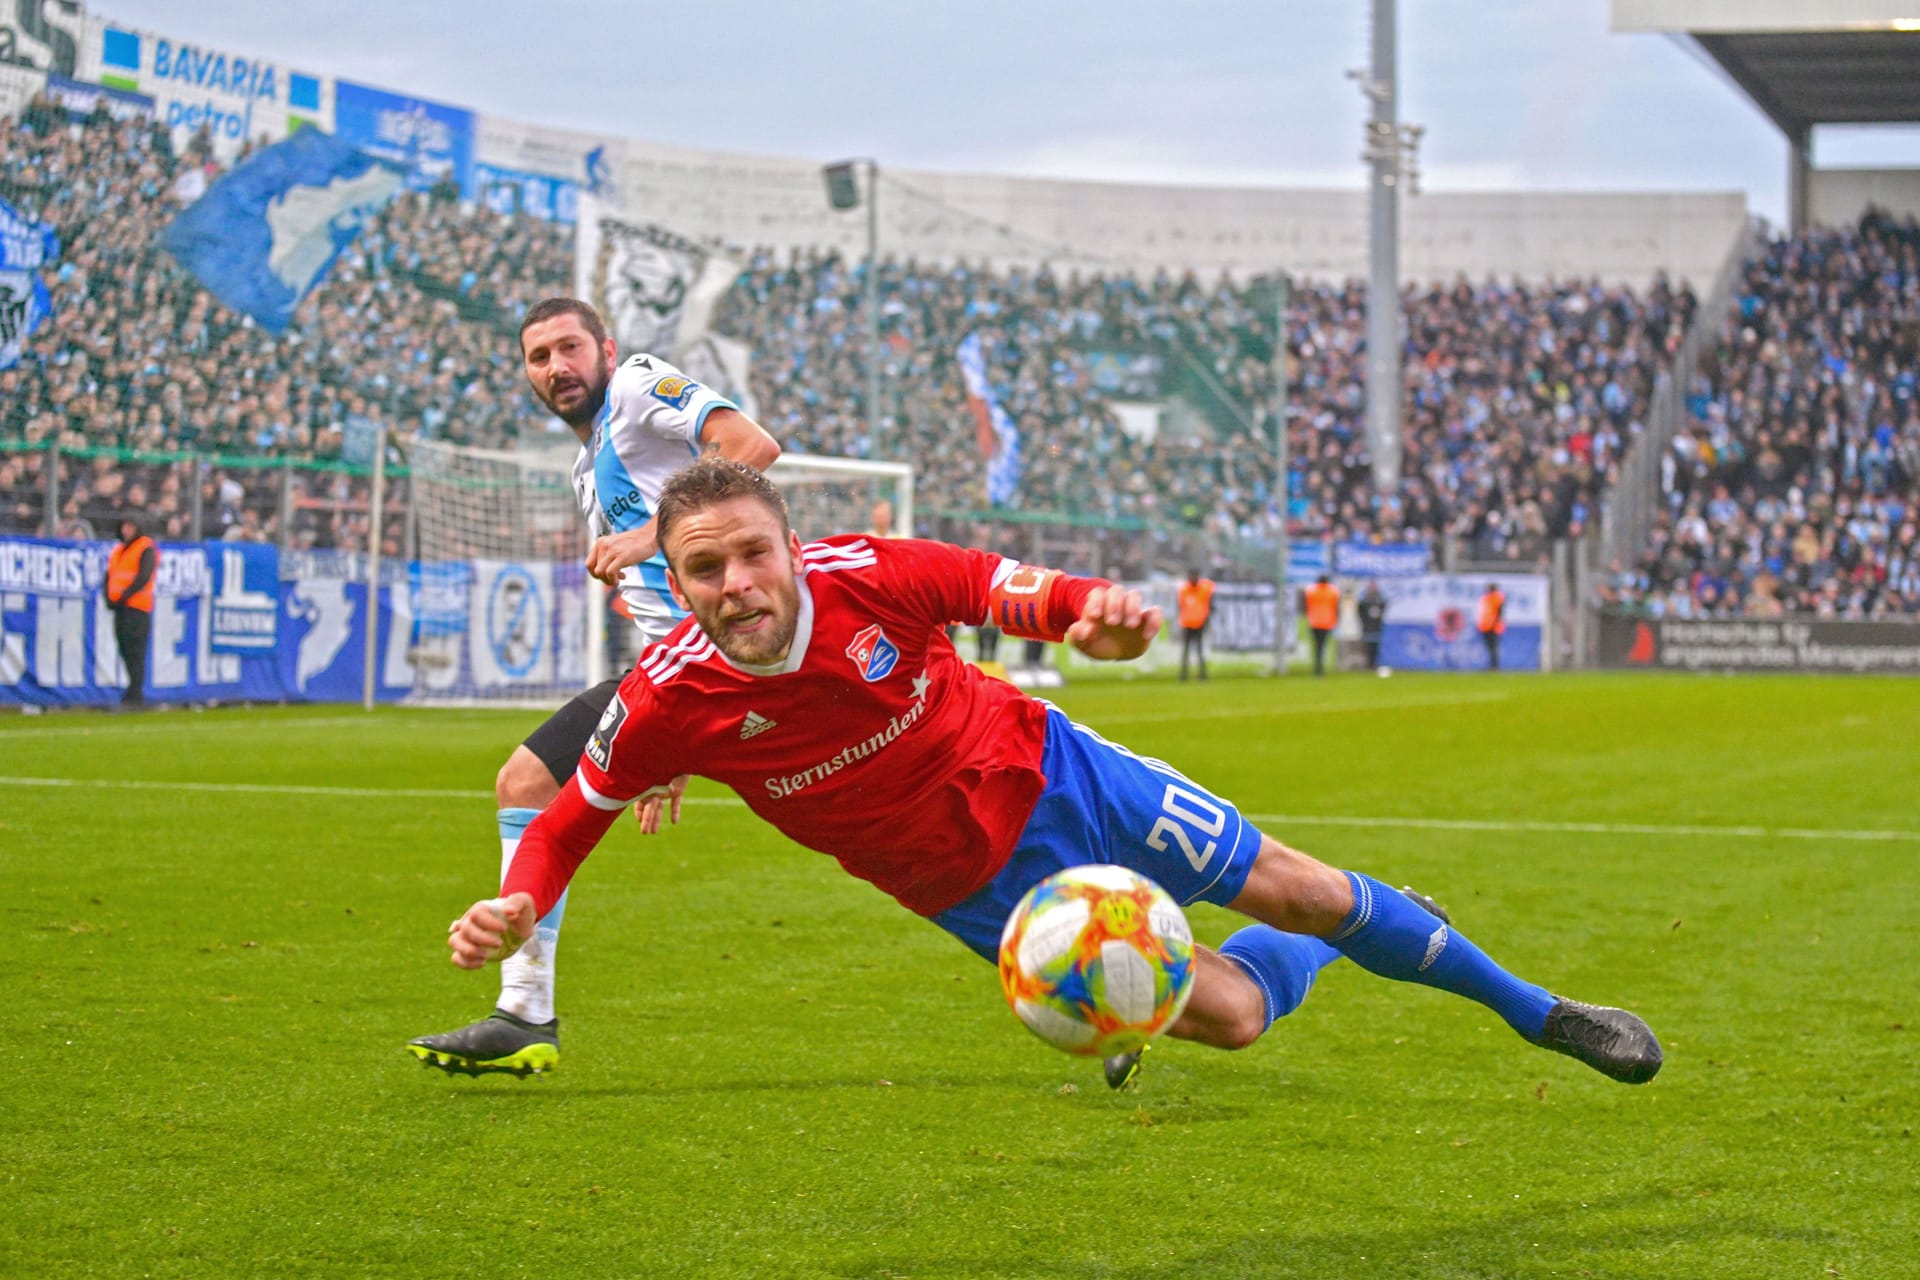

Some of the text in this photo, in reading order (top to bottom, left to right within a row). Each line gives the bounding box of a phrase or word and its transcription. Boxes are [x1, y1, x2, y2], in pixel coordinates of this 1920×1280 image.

[153, 39, 277, 98] BAVARIA
[606, 489, 641, 526] sche
[1003, 568, 1046, 595] C
[740, 719, 777, 740] adidas
[764, 699, 925, 800] Sternstunden
[1145, 783, 1226, 873] 20
